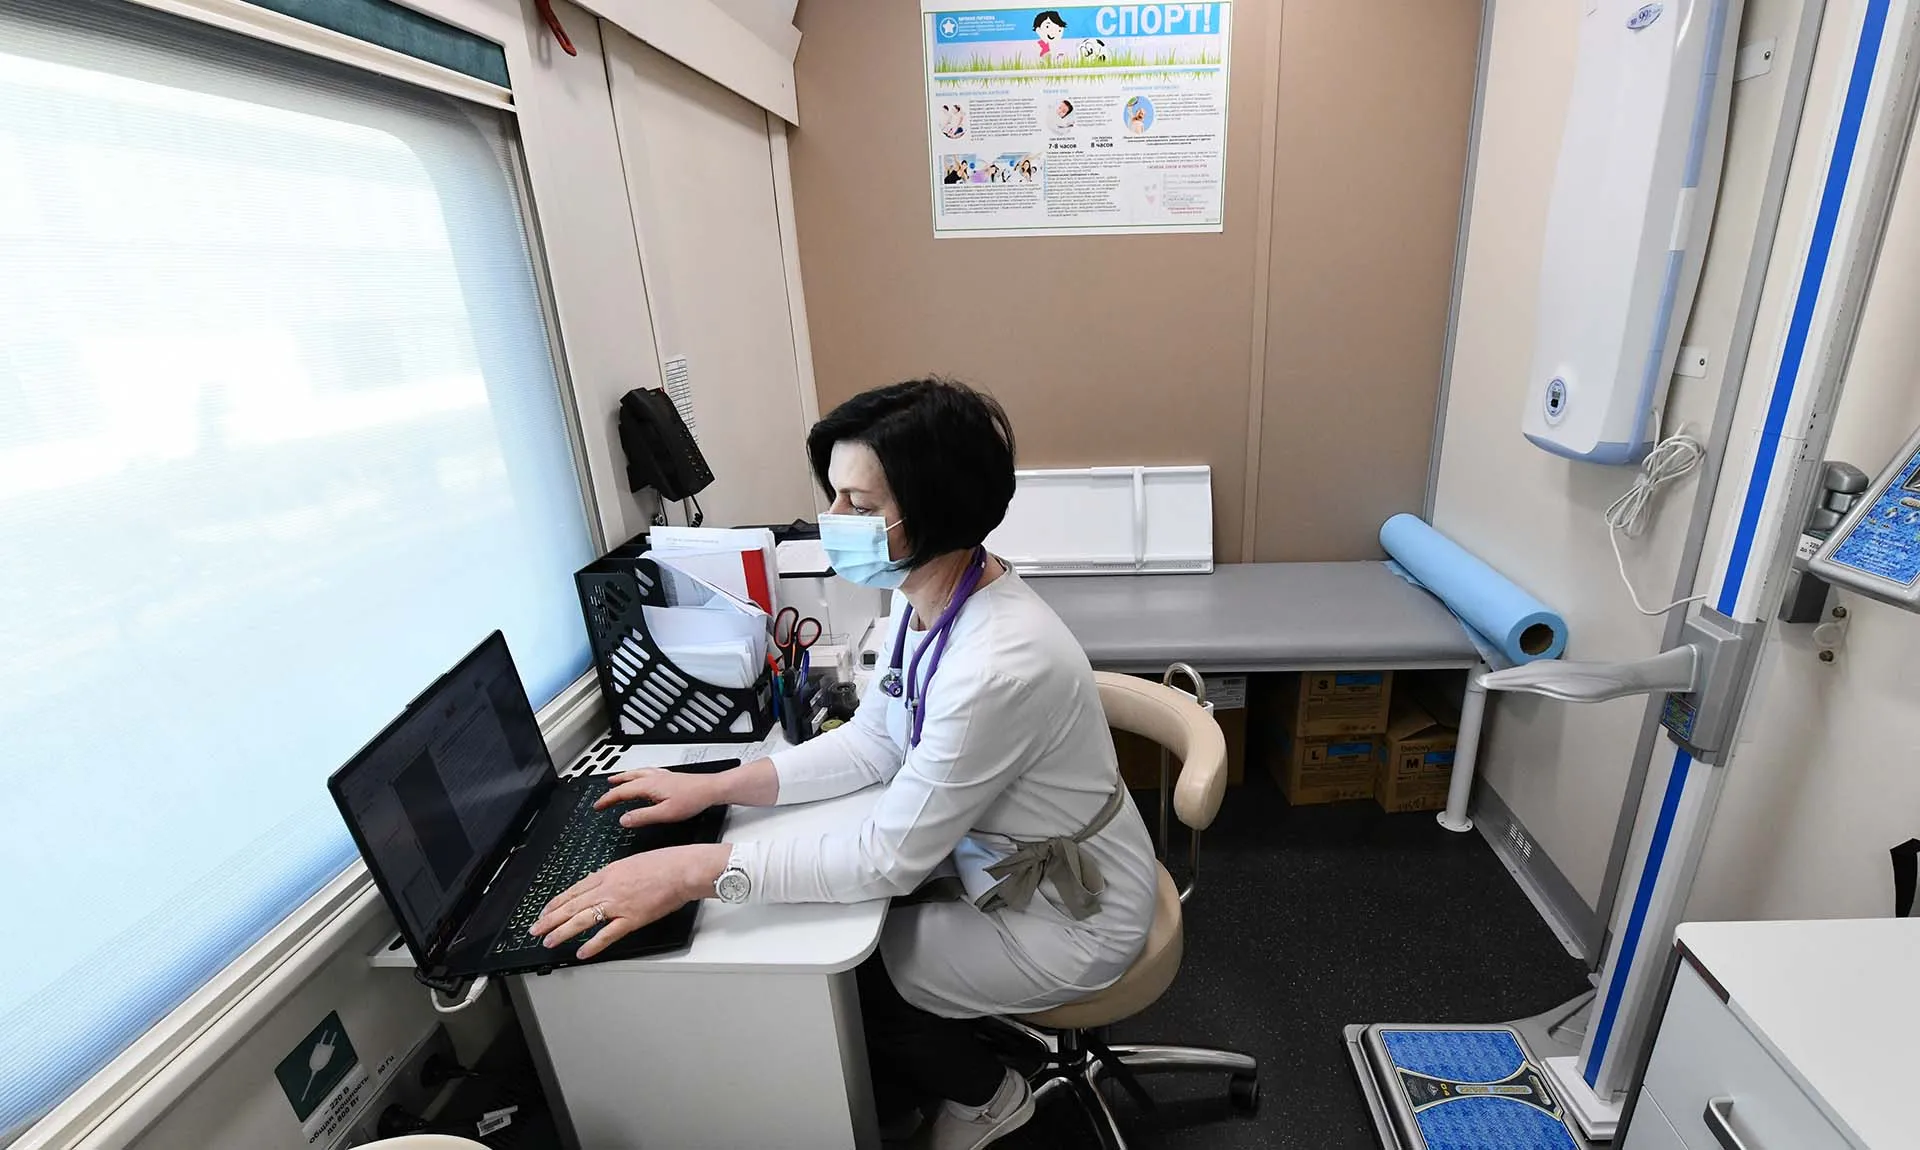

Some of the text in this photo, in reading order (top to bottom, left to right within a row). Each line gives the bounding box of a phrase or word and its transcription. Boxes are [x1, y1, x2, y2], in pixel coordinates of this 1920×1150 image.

[1096, 3, 1212, 36] СПОРТ!
[1318, 679, 1328, 690] S
[1311, 750, 1320, 760] L
[1406, 757, 1419, 769] M
[329, 1094, 343, 1110] 220
[334, 1076, 369, 1115] мощность
